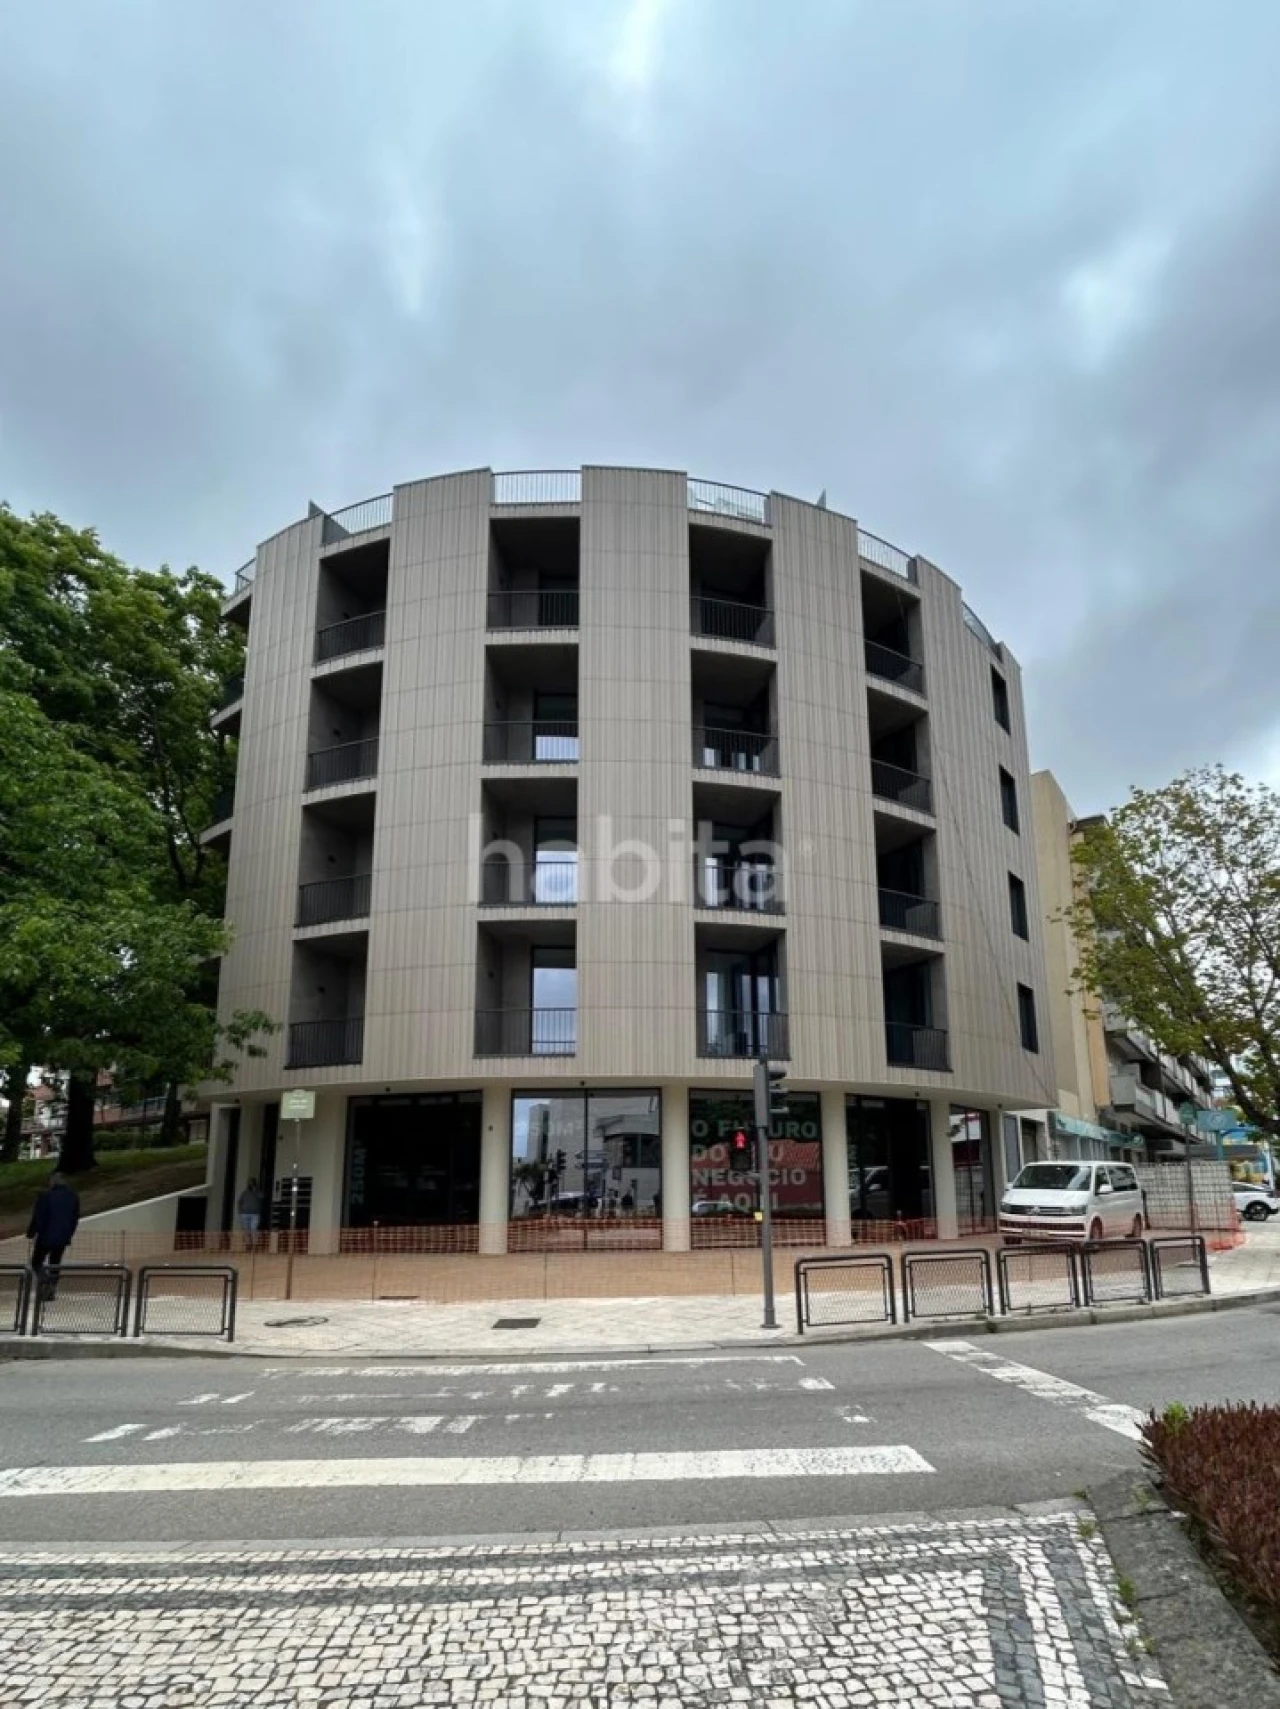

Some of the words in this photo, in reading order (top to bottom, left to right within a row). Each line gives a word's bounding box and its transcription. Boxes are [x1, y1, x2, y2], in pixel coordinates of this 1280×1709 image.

[691, 1119, 708, 1138] O
[717, 1119, 818, 1138] FURO
[692, 1143, 727, 1163] DO
[693, 1169, 807, 1187] NEGCIO
